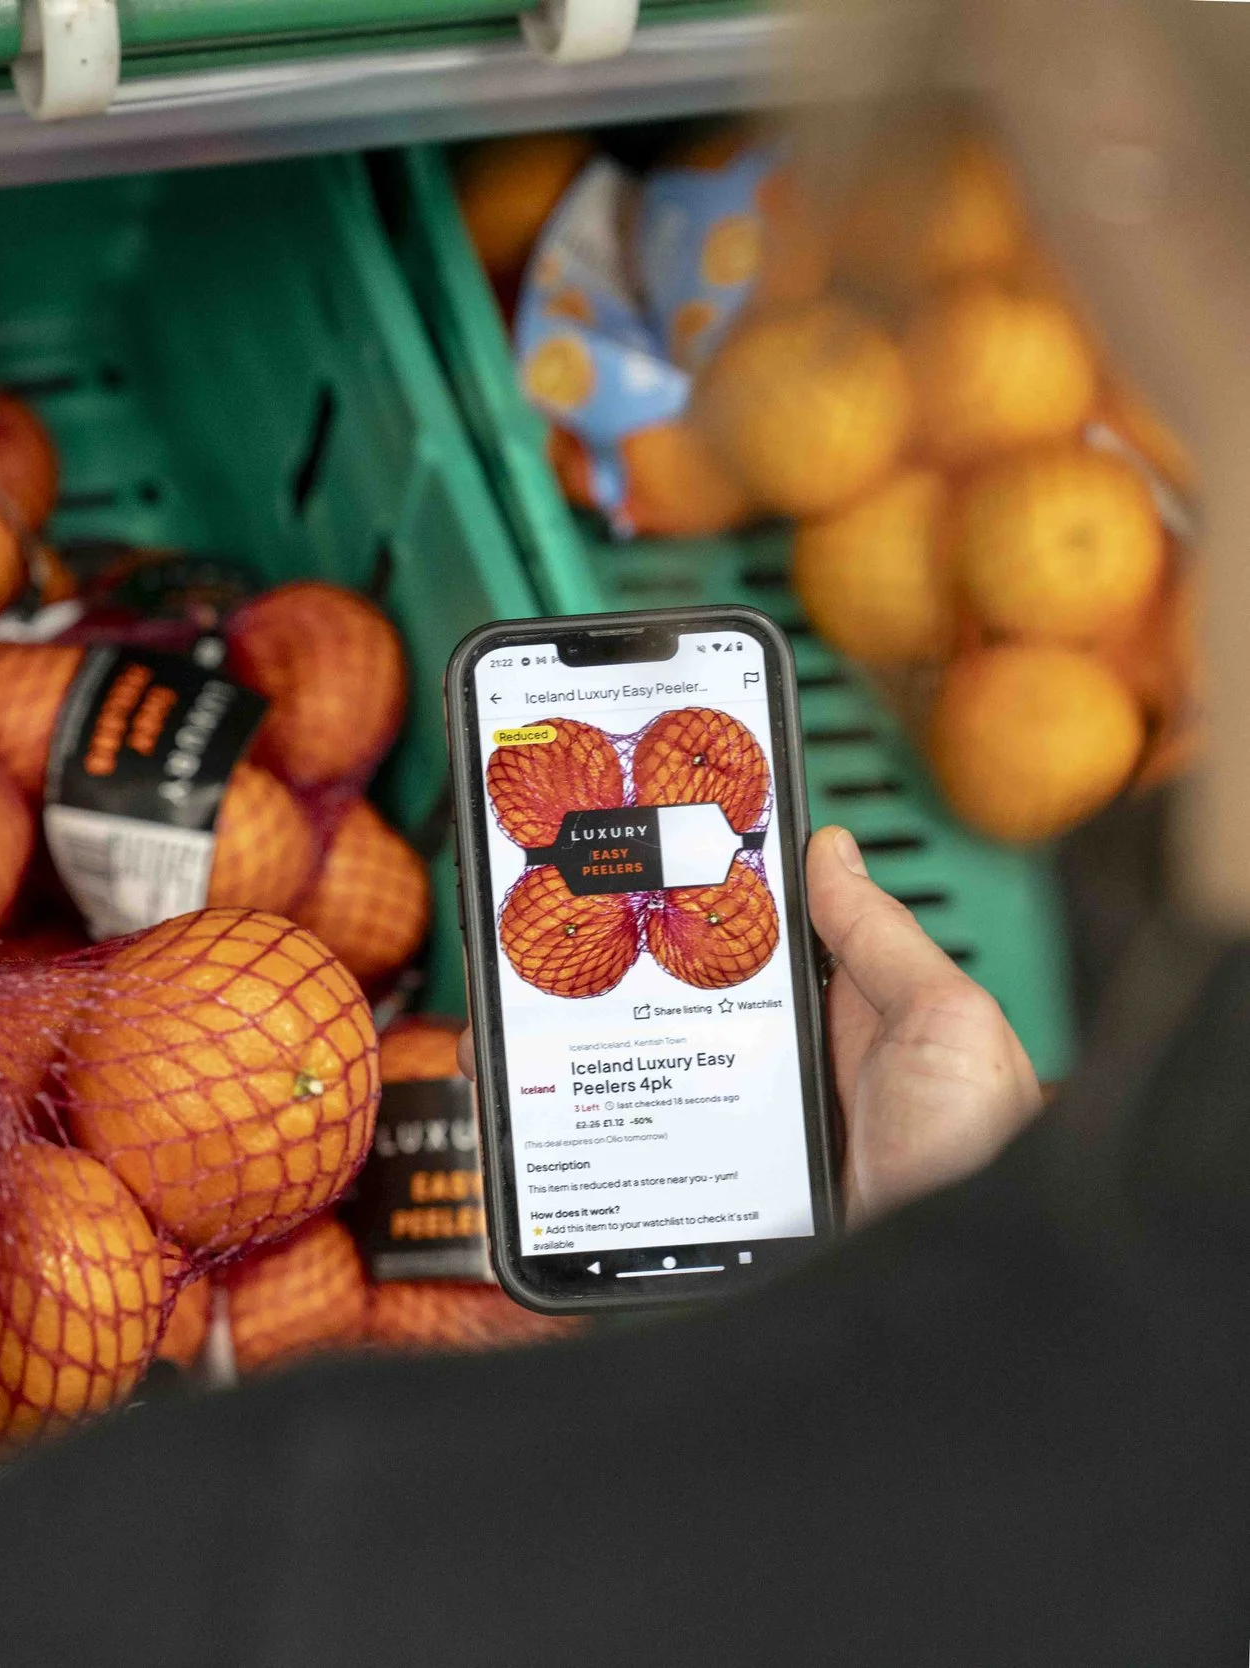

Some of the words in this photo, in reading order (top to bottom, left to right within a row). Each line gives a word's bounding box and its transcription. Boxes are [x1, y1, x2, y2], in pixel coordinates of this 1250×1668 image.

[490, 658, 513, 668] 21:22
[525, 689, 575, 704] Iceland
[578, 686, 620, 701] Luxury
[623, 684, 654, 699] Easy
[656, 681, 708, 695] Peeler...
[499, 730, 548, 743] Reduced
[571, 825, 648, 842] LUXURY
[592, 848, 628, 861] EASY
[582, 862, 643, 877] PEELERS
[654, 1006, 682, 1017] Share
[683, 1004, 712, 1015] listing
[737, 999, 783, 1011] Watchlist
[569, 1042, 600, 1052] Iceland
[634, 1038, 664, 1047] Kentish
[665, 1036, 687, 1045] Town
[571, 1058, 633, 1075] Iceland
[637, 1055, 693, 1072] Luxury
[697, 1052, 736, 1068] Easy
[520, 1084, 556, 1096] Iceland
[573, 1079, 636, 1096] Peelers
[640, 1075, 673, 1092] 4pk
[574, 1104, 581, 1112] 3
[582, 1103, 600, 1112] Left
[617, 1101, 633, 1109] last
[634, 1098, 672, 1108] checked
[674, 1097, 683, 1105] 18
[684, 1095, 722, 1105] seconds
[723, 1094, 740, 1104] ago
[603, 1118, 625, 1127] £1.12
[629, 1116, 653, 1125] -50%
[376, 1118, 481, 1157] LUXU
[525, 1140, 543, 1150] (This
[544, 1138, 562, 1148] deal
[563, 1136, 592, 1147] expires
[624, 1132, 668, 1142] tomorrow)
[527, 1160, 591, 1174] Description
[528, 1185, 547, 1194] This
[548, 1183, 569, 1193] item
[570, 1183, 579, 1191] is
[579, 1180, 621, 1191] reduced
[622, 1179, 632, 1188] at
[640, 1177, 665, 1187] store
[666, 1177, 688, 1185] near
[688, 1175, 707, 1185] you
[714, 1171, 739, 1183] yum!
[530, 1210, 553, 1220] How
[555, 1208, 580, 1218] does
[581, 1207, 588, 1217] it
[589, 1205, 621, 1216] work?
[545, 1224, 566, 1235] Add
[567, 1223, 584, 1233] this
[585, 1221, 607, 1232] item
[608, 1220, 619, 1230] to
[620, 1221, 642, 1232] your
[642, 1217, 684, 1228] watchlist
[685, 1215, 696, 1225] to
[697, 1213, 726, 1224] check
[743, 1211, 759, 1221] still
[533, 1240, 575, 1250] available
